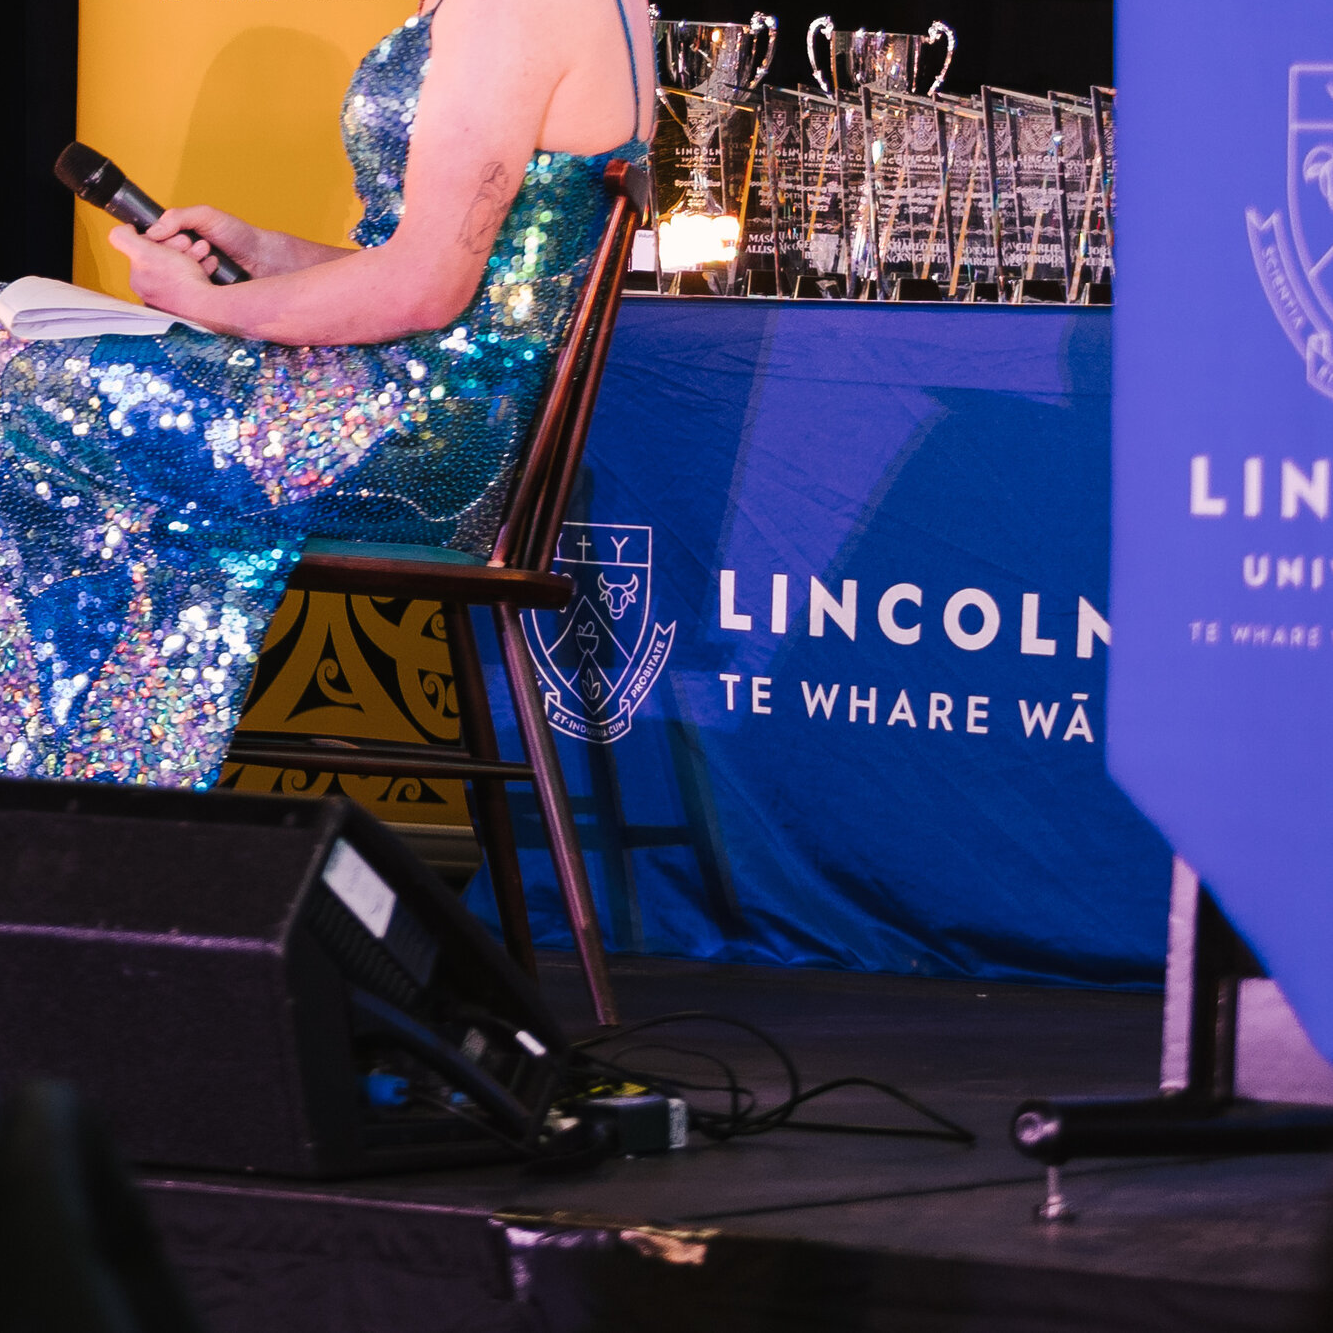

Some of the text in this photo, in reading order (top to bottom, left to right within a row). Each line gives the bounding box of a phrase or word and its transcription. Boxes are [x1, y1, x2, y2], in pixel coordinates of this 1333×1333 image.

[1190, 455, 1330, 520] LIN
[1243, 553, 1333, 589] UNI
[719, 569, 1113, 659] LINCOLN
[1189, 620, 1219, 643] TE
[630, 640, 666, 699] PROBITATE
[719, 673, 772, 715] TE
[801, 680, 990, 734] WHARE
